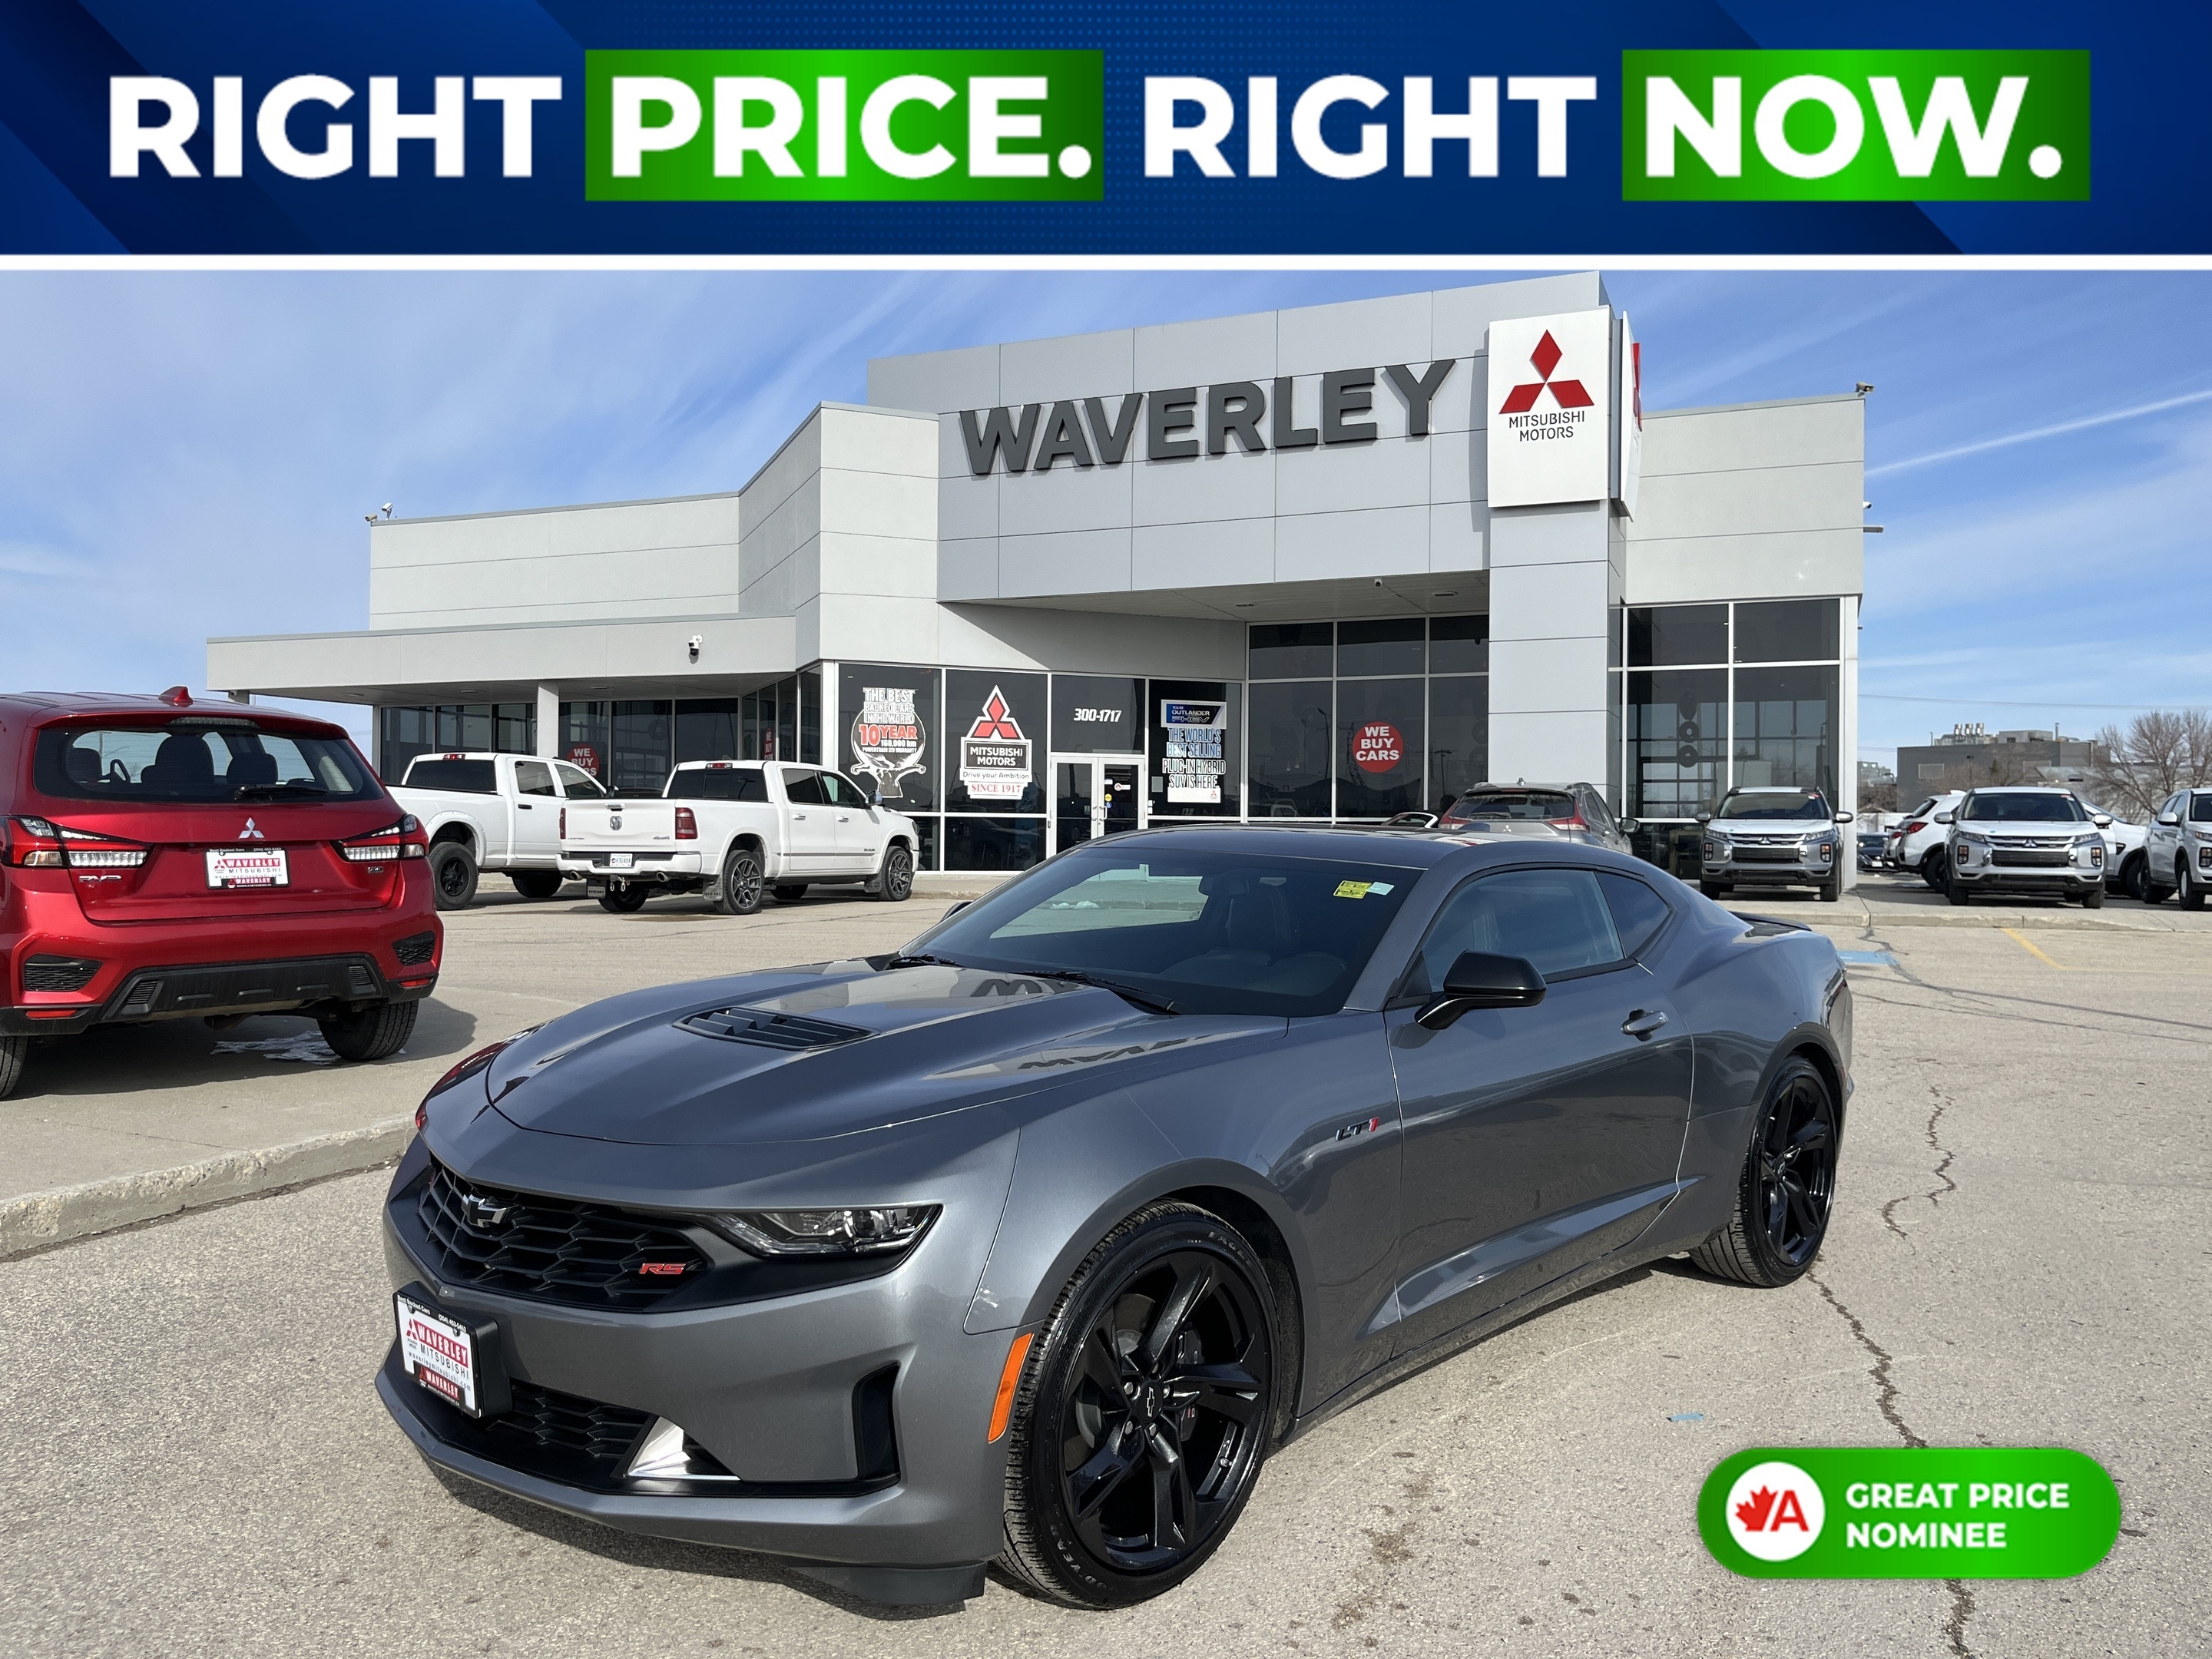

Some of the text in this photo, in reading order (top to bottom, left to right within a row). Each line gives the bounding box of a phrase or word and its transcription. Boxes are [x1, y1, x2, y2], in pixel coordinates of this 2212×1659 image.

[959, 359, 1455, 475] WAVERLEY
[1509, 411, 1584, 428] MITSUBISHI
[1519, 426, 1574, 442] MOTORS
[863, 687, 916, 704] THE BEST
[865, 703, 915, 714] BACKED CARS
[1073, 708, 1122, 722] 300-1717
[865, 714, 915, 724] IN THE WORLD
[859, 724, 918, 746] 10 YEAR
[1168, 728, 1221, 743] THE WORLD'S
[1364, 726, 1389, 737] WE
[1167, 743, 1221, 758] BEST SELLING
[1361, 738, 1394, 749] BUY
[574, 748, 591, 757] WE
[970, 747, 1023, 757] MITSUBISHI
[1356, 750, 1399, 761] CARS
[977, 757, 1016, 766] MOTORS
[1163, 758, 1226, 775] PLUG-IN HYBRID
[972, 784, 998, 793] SINCE
[1169, 774, 1187, 789] SUV
[1187, 774, 1195, 789] IS
[227, 859, 280, 867] WAVERLEY
[1335, 1117, 1379, 1142] LT1
[639, 1263, 687, 1275] RS
[417, 1323, 468, 1366] WAVERLEY
[420, 1343, 469, 1380] MITSUBISHI
[426, 1369, 459, 1398] WAVERLEY
